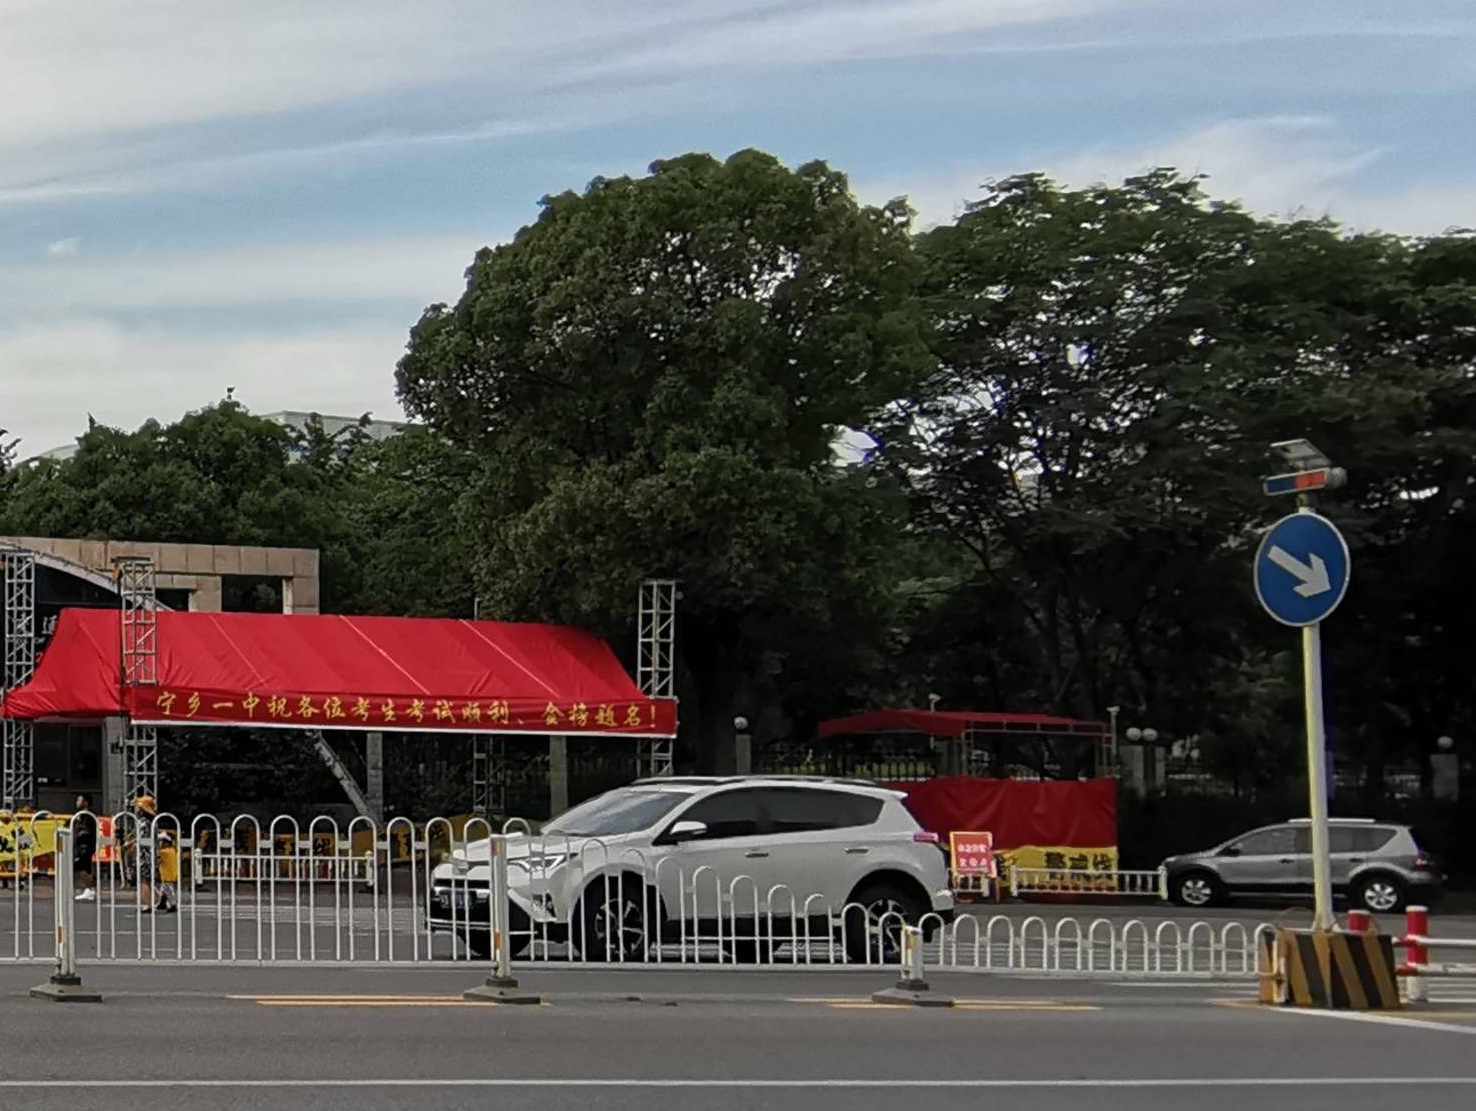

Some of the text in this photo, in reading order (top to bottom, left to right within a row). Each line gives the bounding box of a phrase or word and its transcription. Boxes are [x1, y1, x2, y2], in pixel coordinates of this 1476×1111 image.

[156, 690, 657, 729] 宁乡一中祝各位考生考试顺利、金榜题名！
